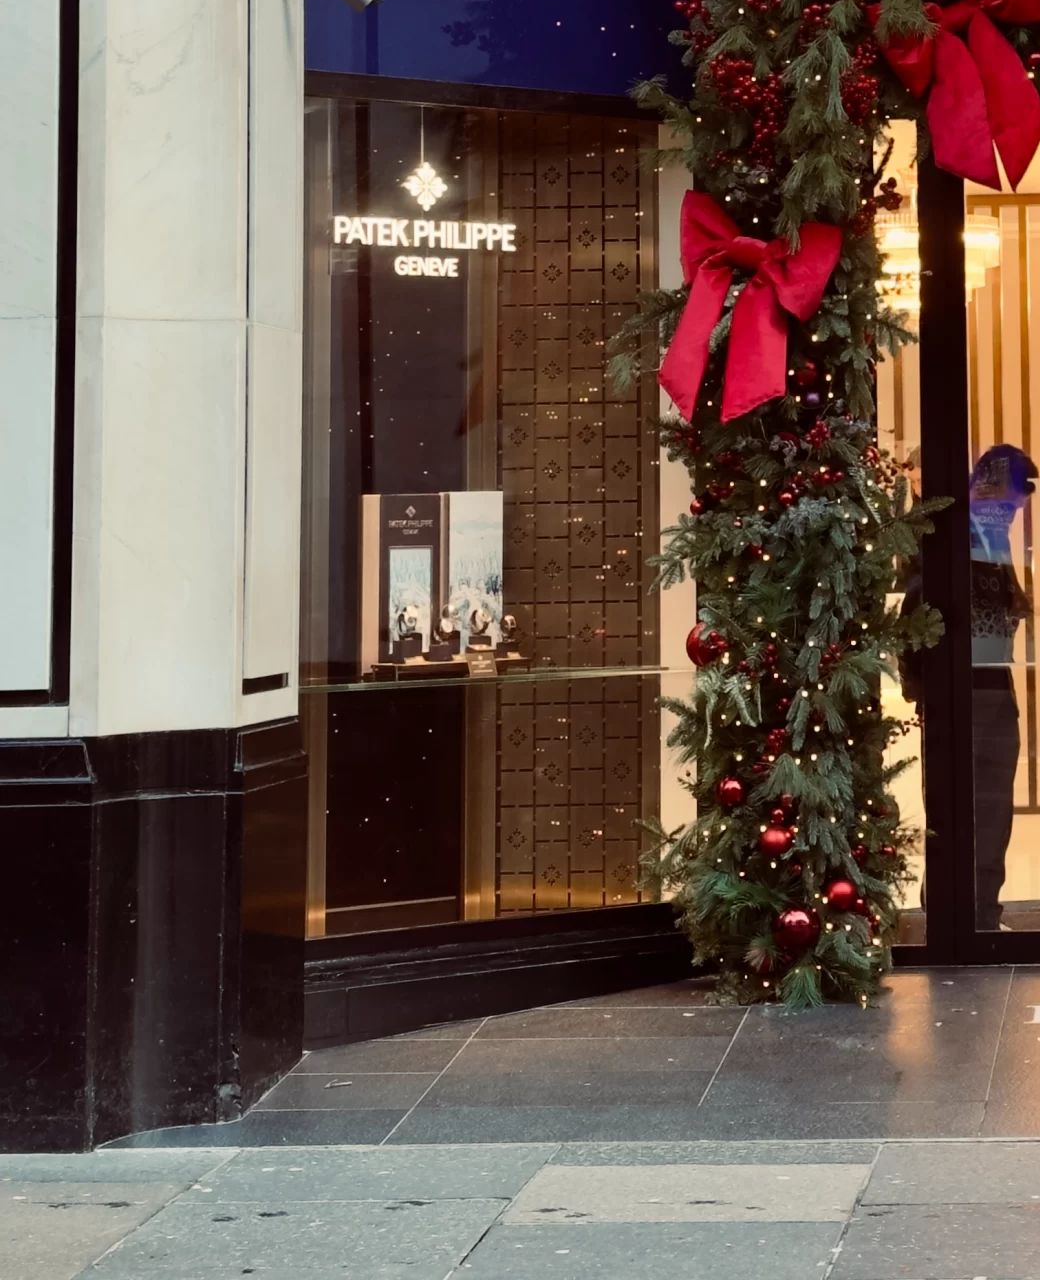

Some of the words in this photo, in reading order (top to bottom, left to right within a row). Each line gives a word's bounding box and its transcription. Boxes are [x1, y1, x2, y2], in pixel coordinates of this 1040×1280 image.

[333, 215, 410, 247] PATEK
[413, 219, 517, 252] PHILIPPE
[394, 256, 459, 278] GENEVE
